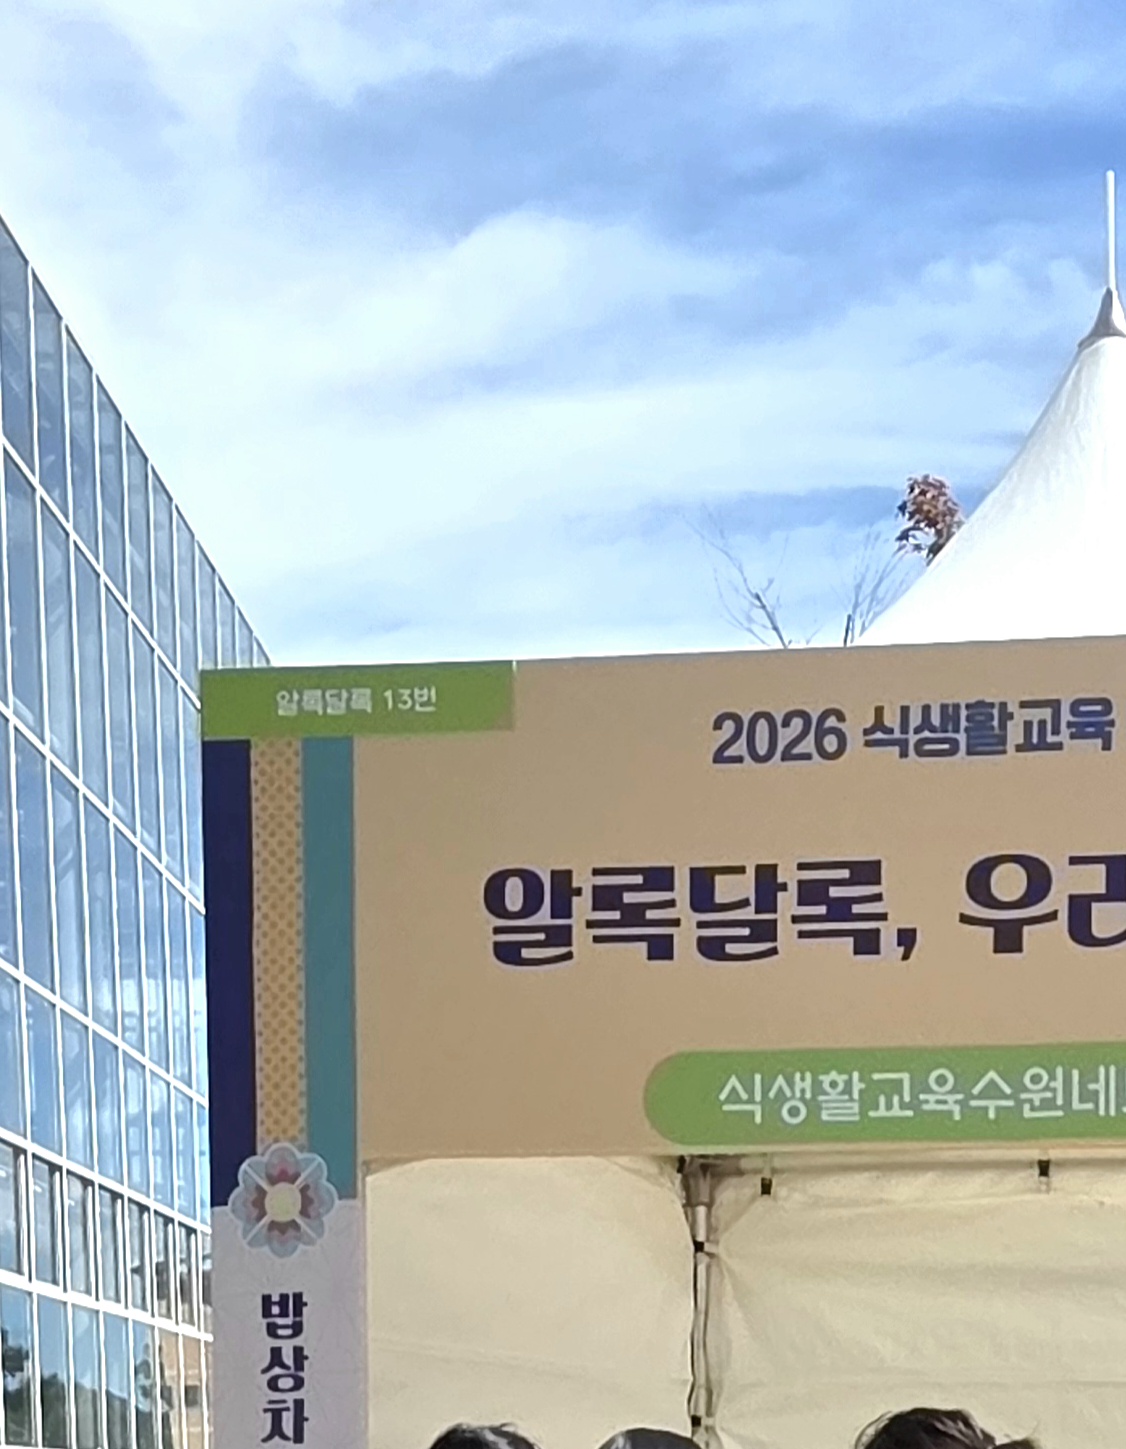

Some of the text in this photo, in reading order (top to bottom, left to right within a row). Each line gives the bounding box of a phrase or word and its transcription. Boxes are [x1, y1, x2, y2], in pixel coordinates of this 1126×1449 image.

[275, 685, 438, 717] 알록달록 13번
[711, 707, 849, 765] 2026
[862, 697, 1117, 759] 식생활교육
[482, 857, 918, 968] 알록달록,
